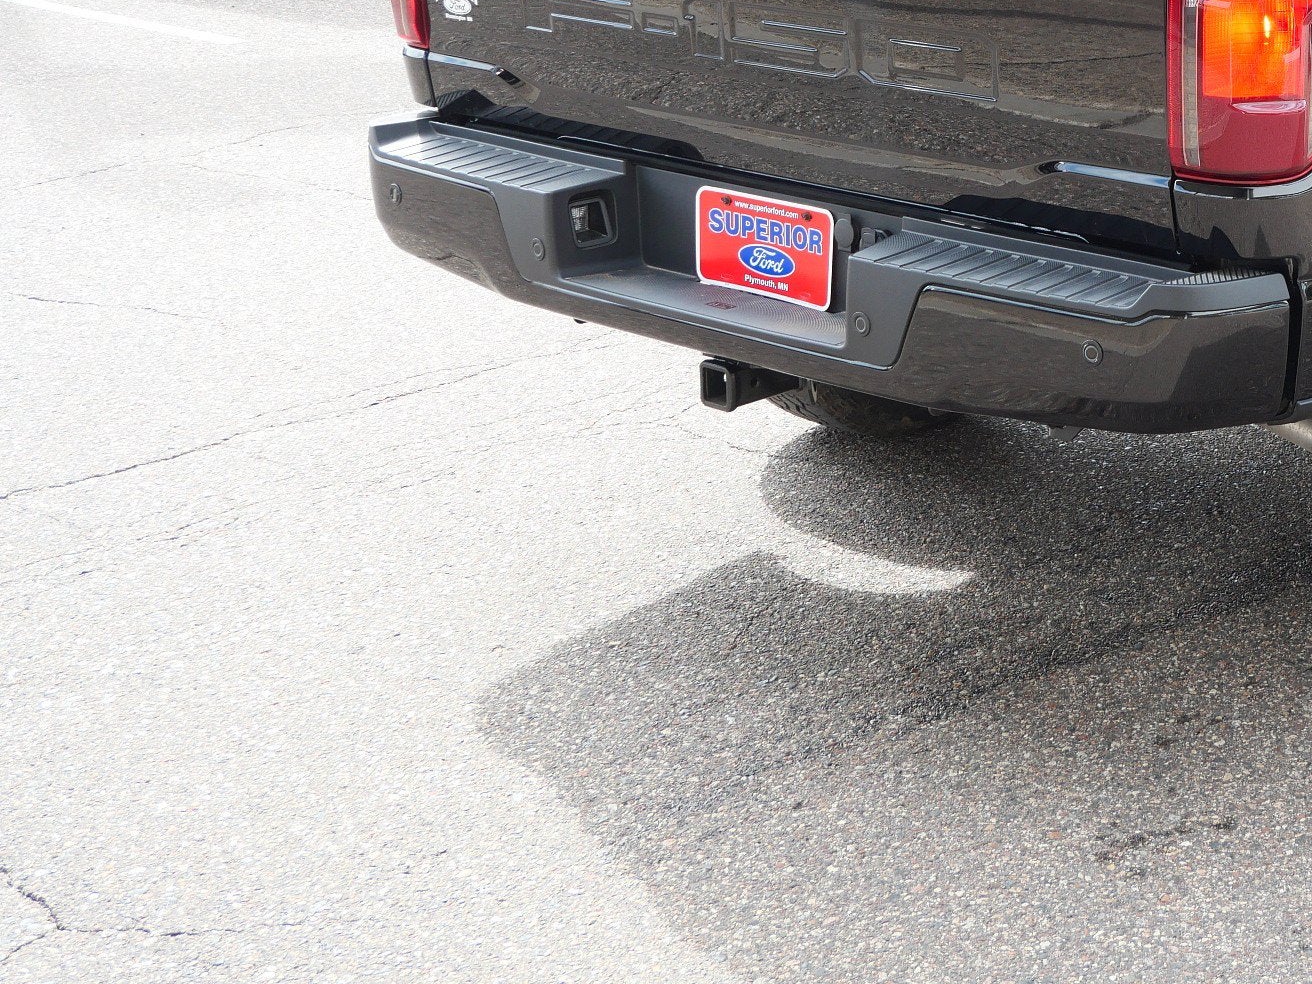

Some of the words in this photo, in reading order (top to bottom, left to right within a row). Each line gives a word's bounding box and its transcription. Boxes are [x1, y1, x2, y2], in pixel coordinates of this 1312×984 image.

[734, 200, 798, 219] www.superiorford.com
[708, 208, 823, 256] SUPERIOR
[749, 247, 784, 273] Ford
[744, 274, 777, 290] Plymouth,
[777, 281, 789, 291] MN
